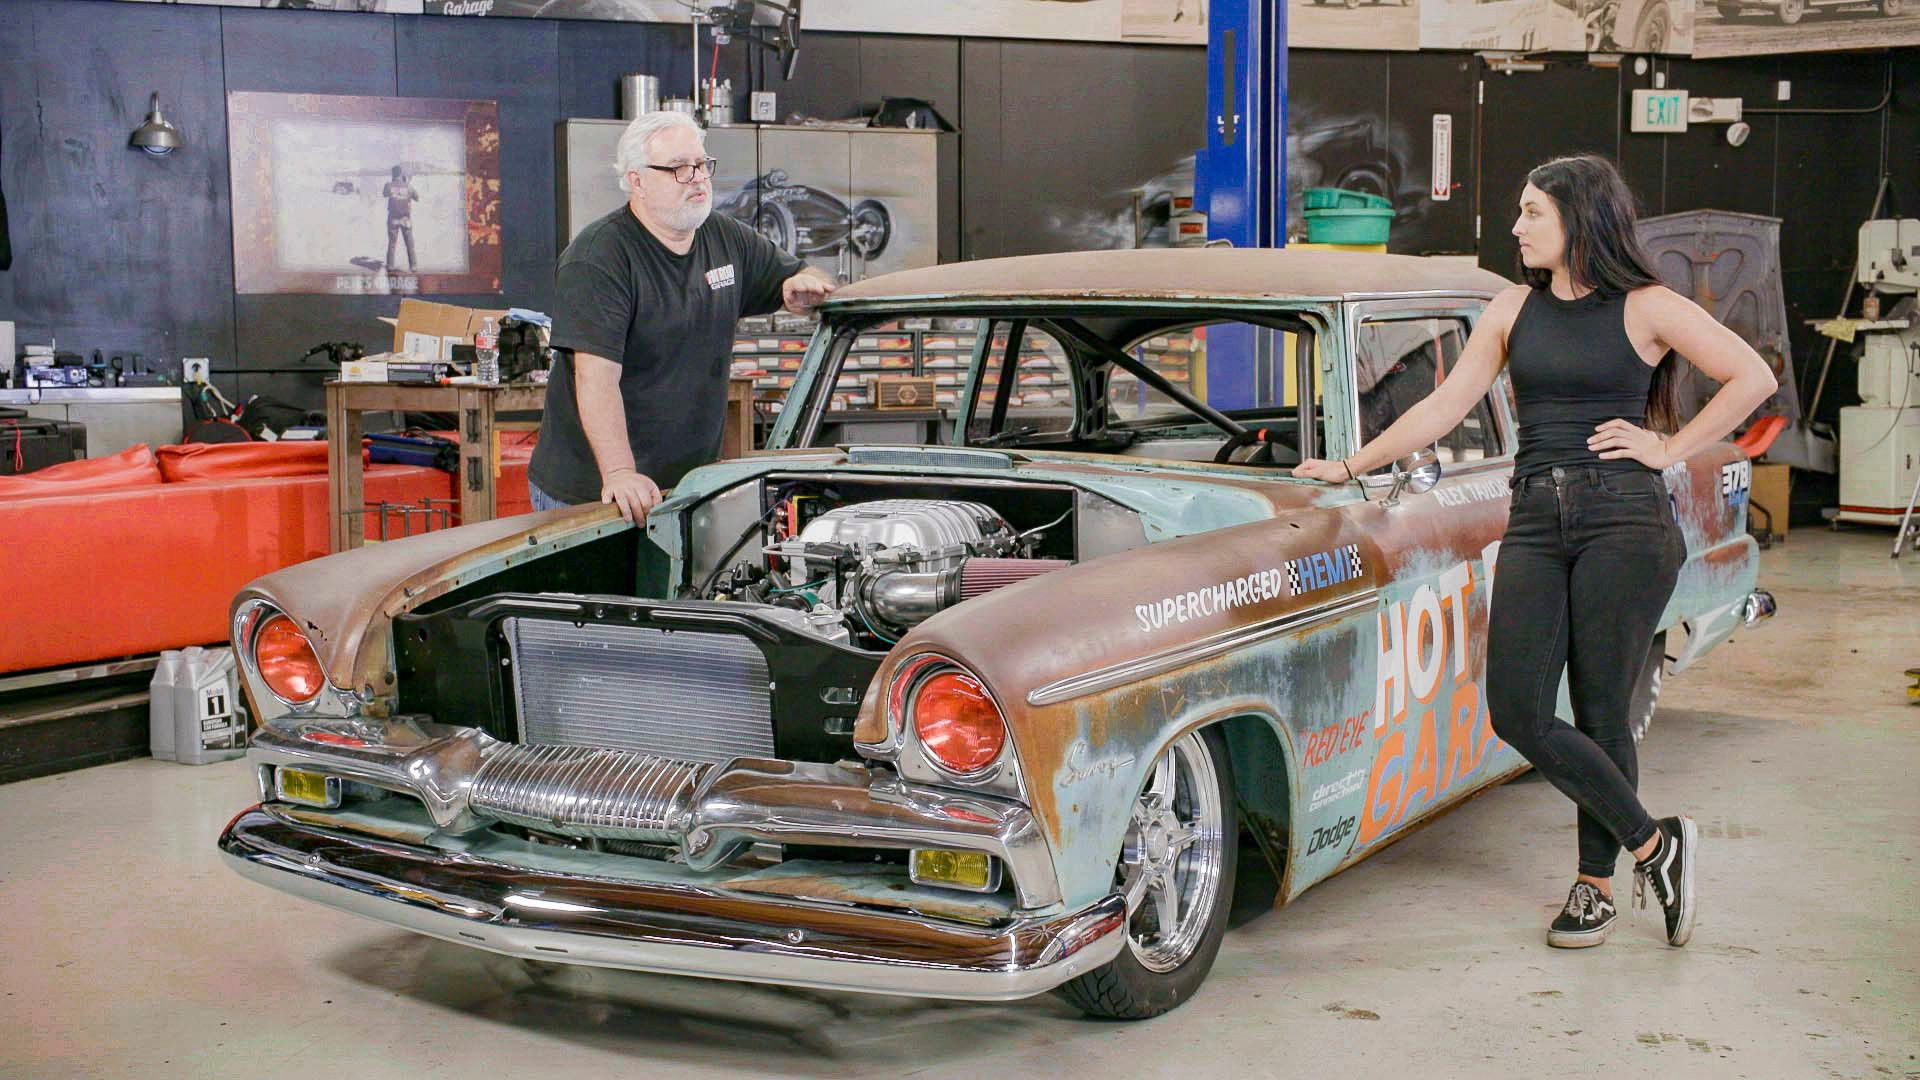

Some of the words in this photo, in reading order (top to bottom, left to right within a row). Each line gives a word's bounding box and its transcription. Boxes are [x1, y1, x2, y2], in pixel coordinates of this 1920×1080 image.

[443, 0, 494, 16] Garage
[1647, 96, 1680, 126] EXIT
[1433, 484, 1472, 507] ALEX
[1135, 568, 1282, 632] SUPERCHARGED
[1296, 546, 1353, 593] HEMI
[1375, 560, 1473, 736] HOT
[1306, 815, 1356, 857] Dodge
